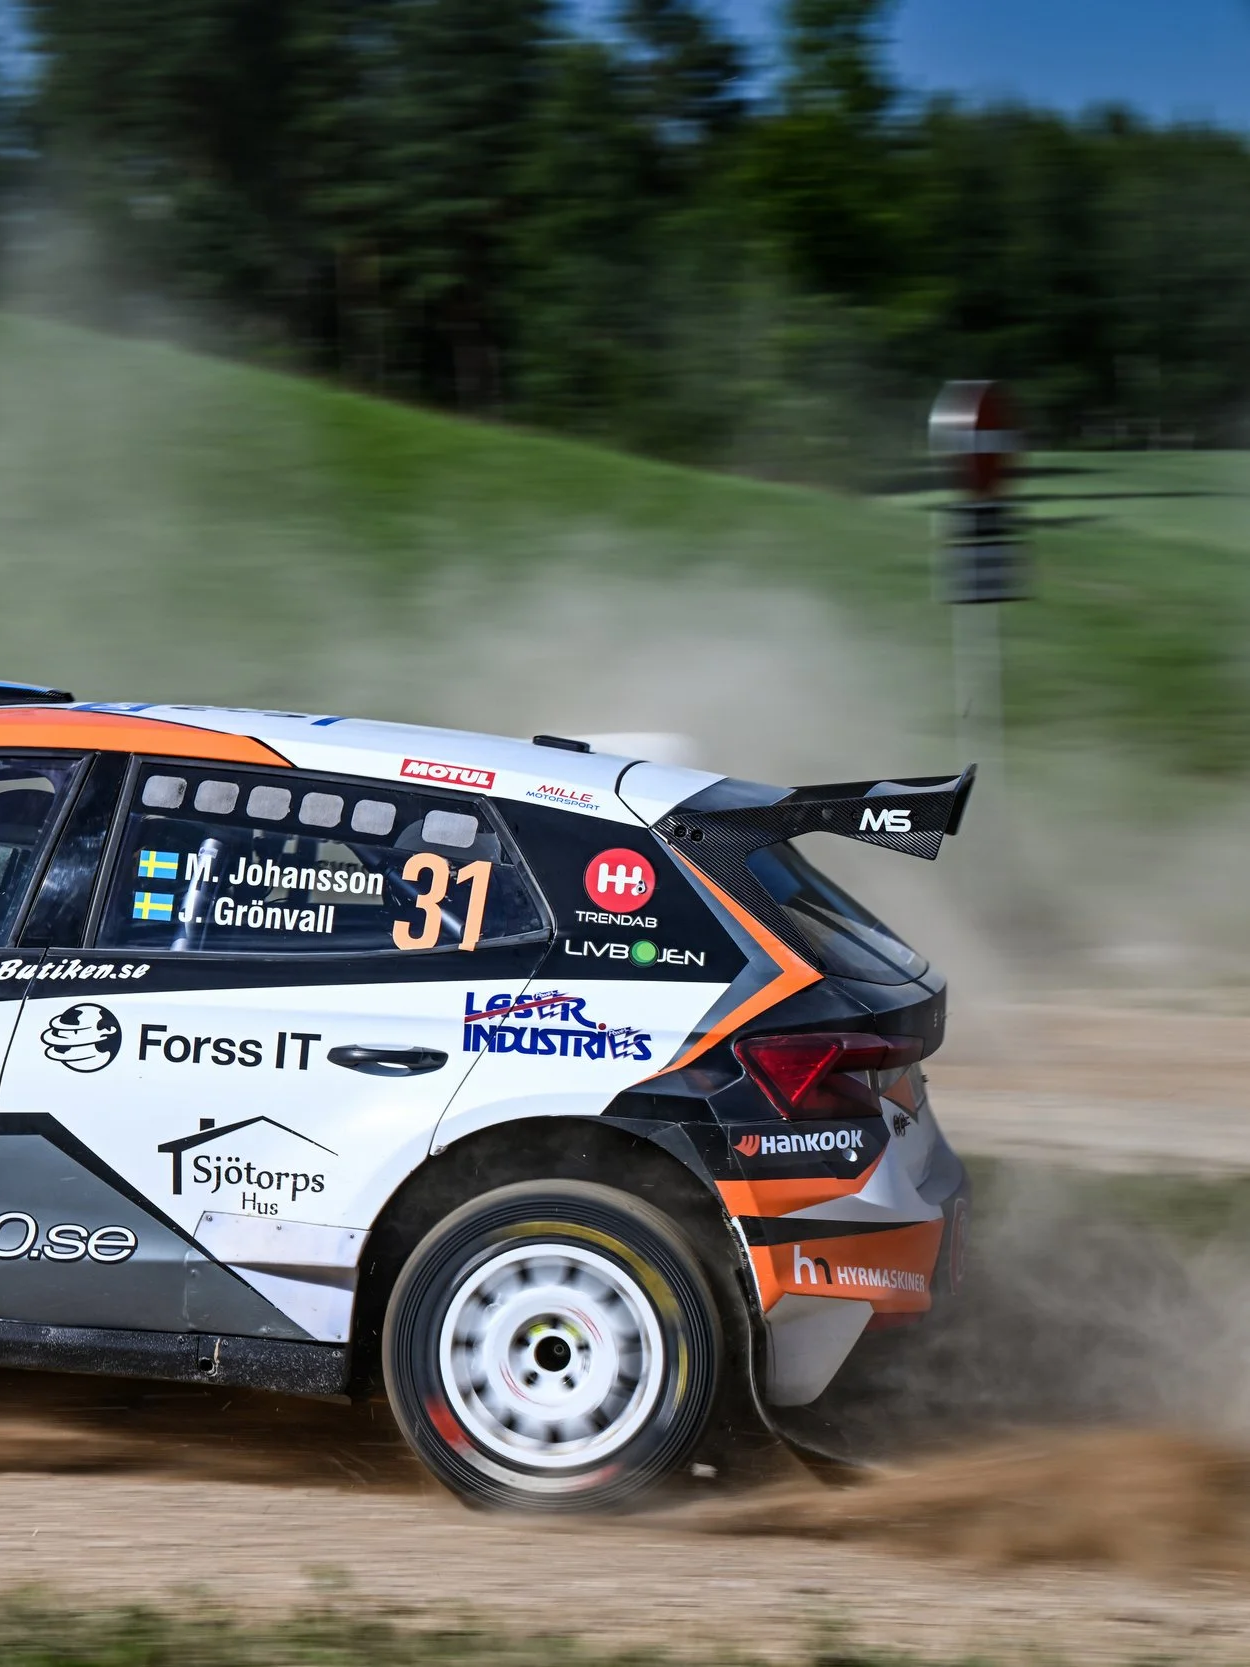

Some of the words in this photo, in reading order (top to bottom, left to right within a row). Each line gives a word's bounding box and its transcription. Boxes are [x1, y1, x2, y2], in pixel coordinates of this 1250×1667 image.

[404, 761, 491, 786] MOTUL
[526, 790, 601, 811] MOTORSPORT
[537, 785, 593, 803] MILLE
[185, 853, 219, 883] M.
[229, 856, 384, 896] Johansson
[178, 895, 202, 924] J.
[214, 896, 335, 934] Grönvall
[392, 852, 493, 952] 31
[575, 910, 658, 929] TRENDAB
[464, 991, 597, 1030] LASER
[139, 1023, 263, 1068] Forss
[275, 1031, 322, 1071] IT
[193, 1154, 326, 1201] Sjötorps
[241, 1191, 279, 1216] Hus
[836, 1265, 926, 1293] HYRMASKINER
